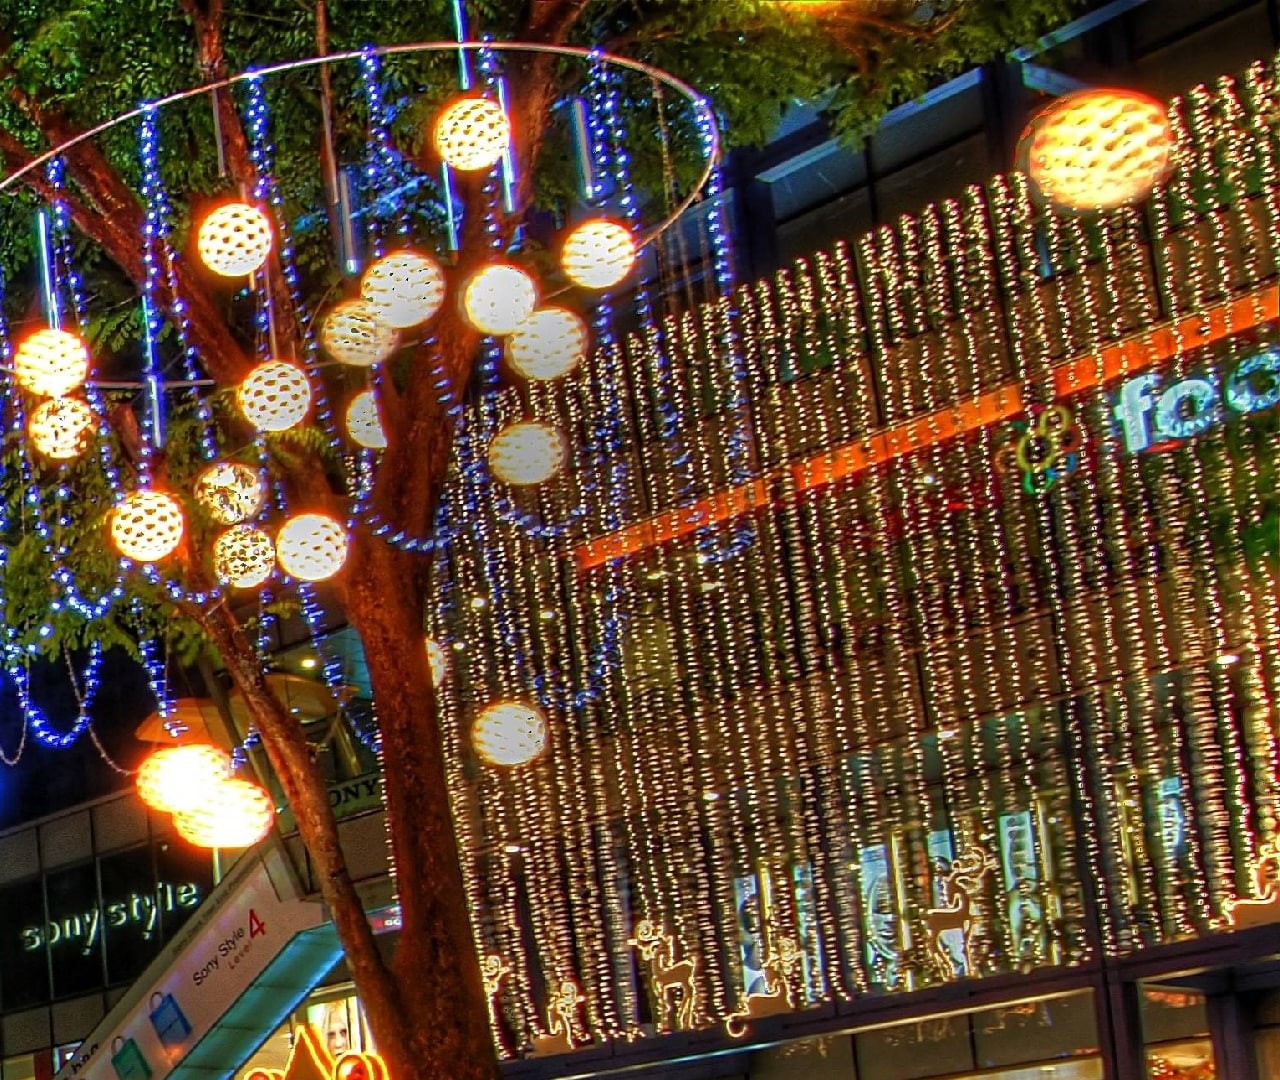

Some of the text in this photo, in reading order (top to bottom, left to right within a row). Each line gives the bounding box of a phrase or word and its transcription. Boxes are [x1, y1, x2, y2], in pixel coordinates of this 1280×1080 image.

[329, 777, 379, 807] ONY
[21, 907, 100, 956] sony
[107, 881, 200, 940] style
[248, 908, 266, 939] 4
[193, 927, 245, 986] Sony Style
